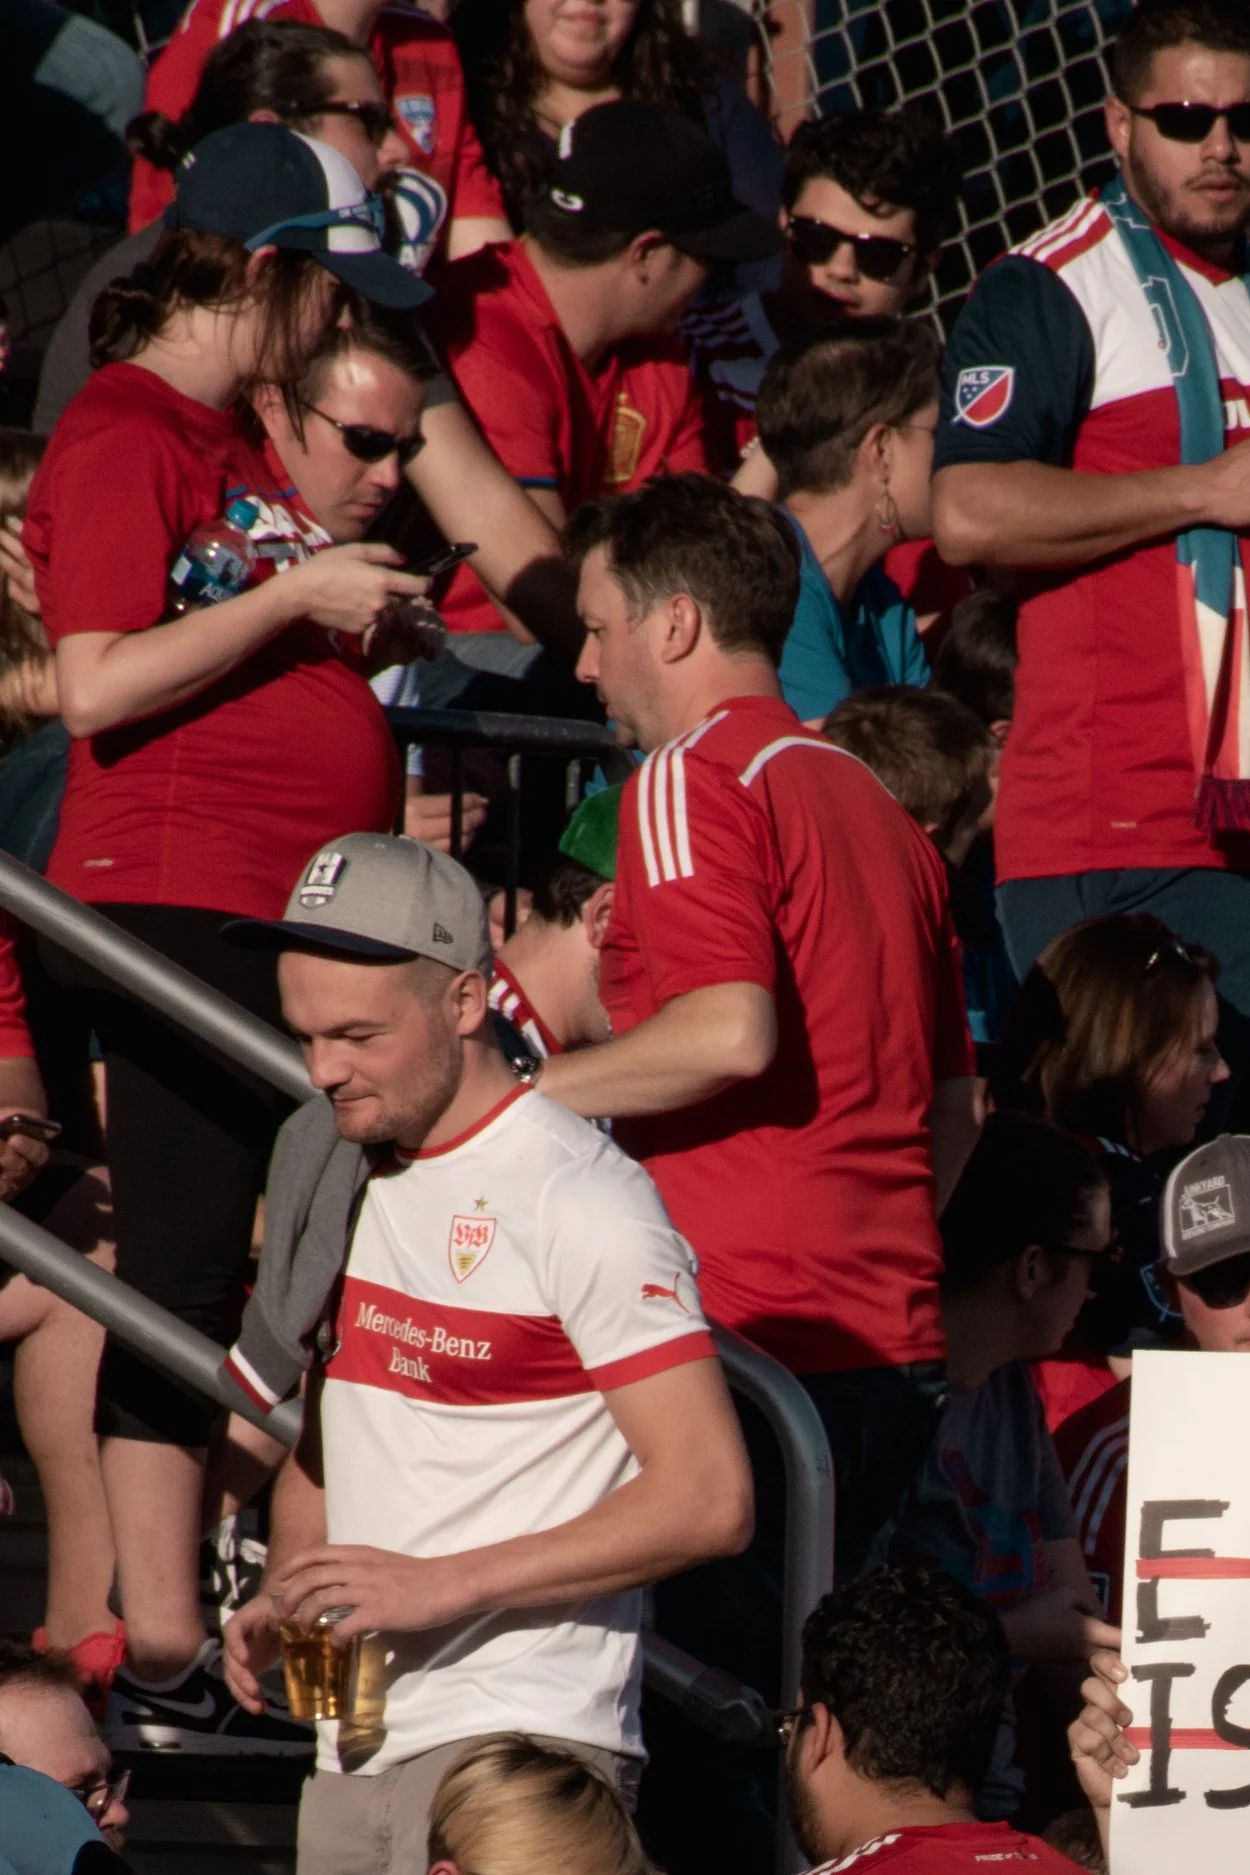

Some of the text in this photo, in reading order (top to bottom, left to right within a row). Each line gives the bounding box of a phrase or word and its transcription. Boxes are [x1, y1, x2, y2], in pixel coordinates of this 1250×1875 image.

[961, 371, 990, 386] MLS
[354, 1302, 492, 1361] Mercedes-Benz
[388, 1346, 433, 1384] Bank
